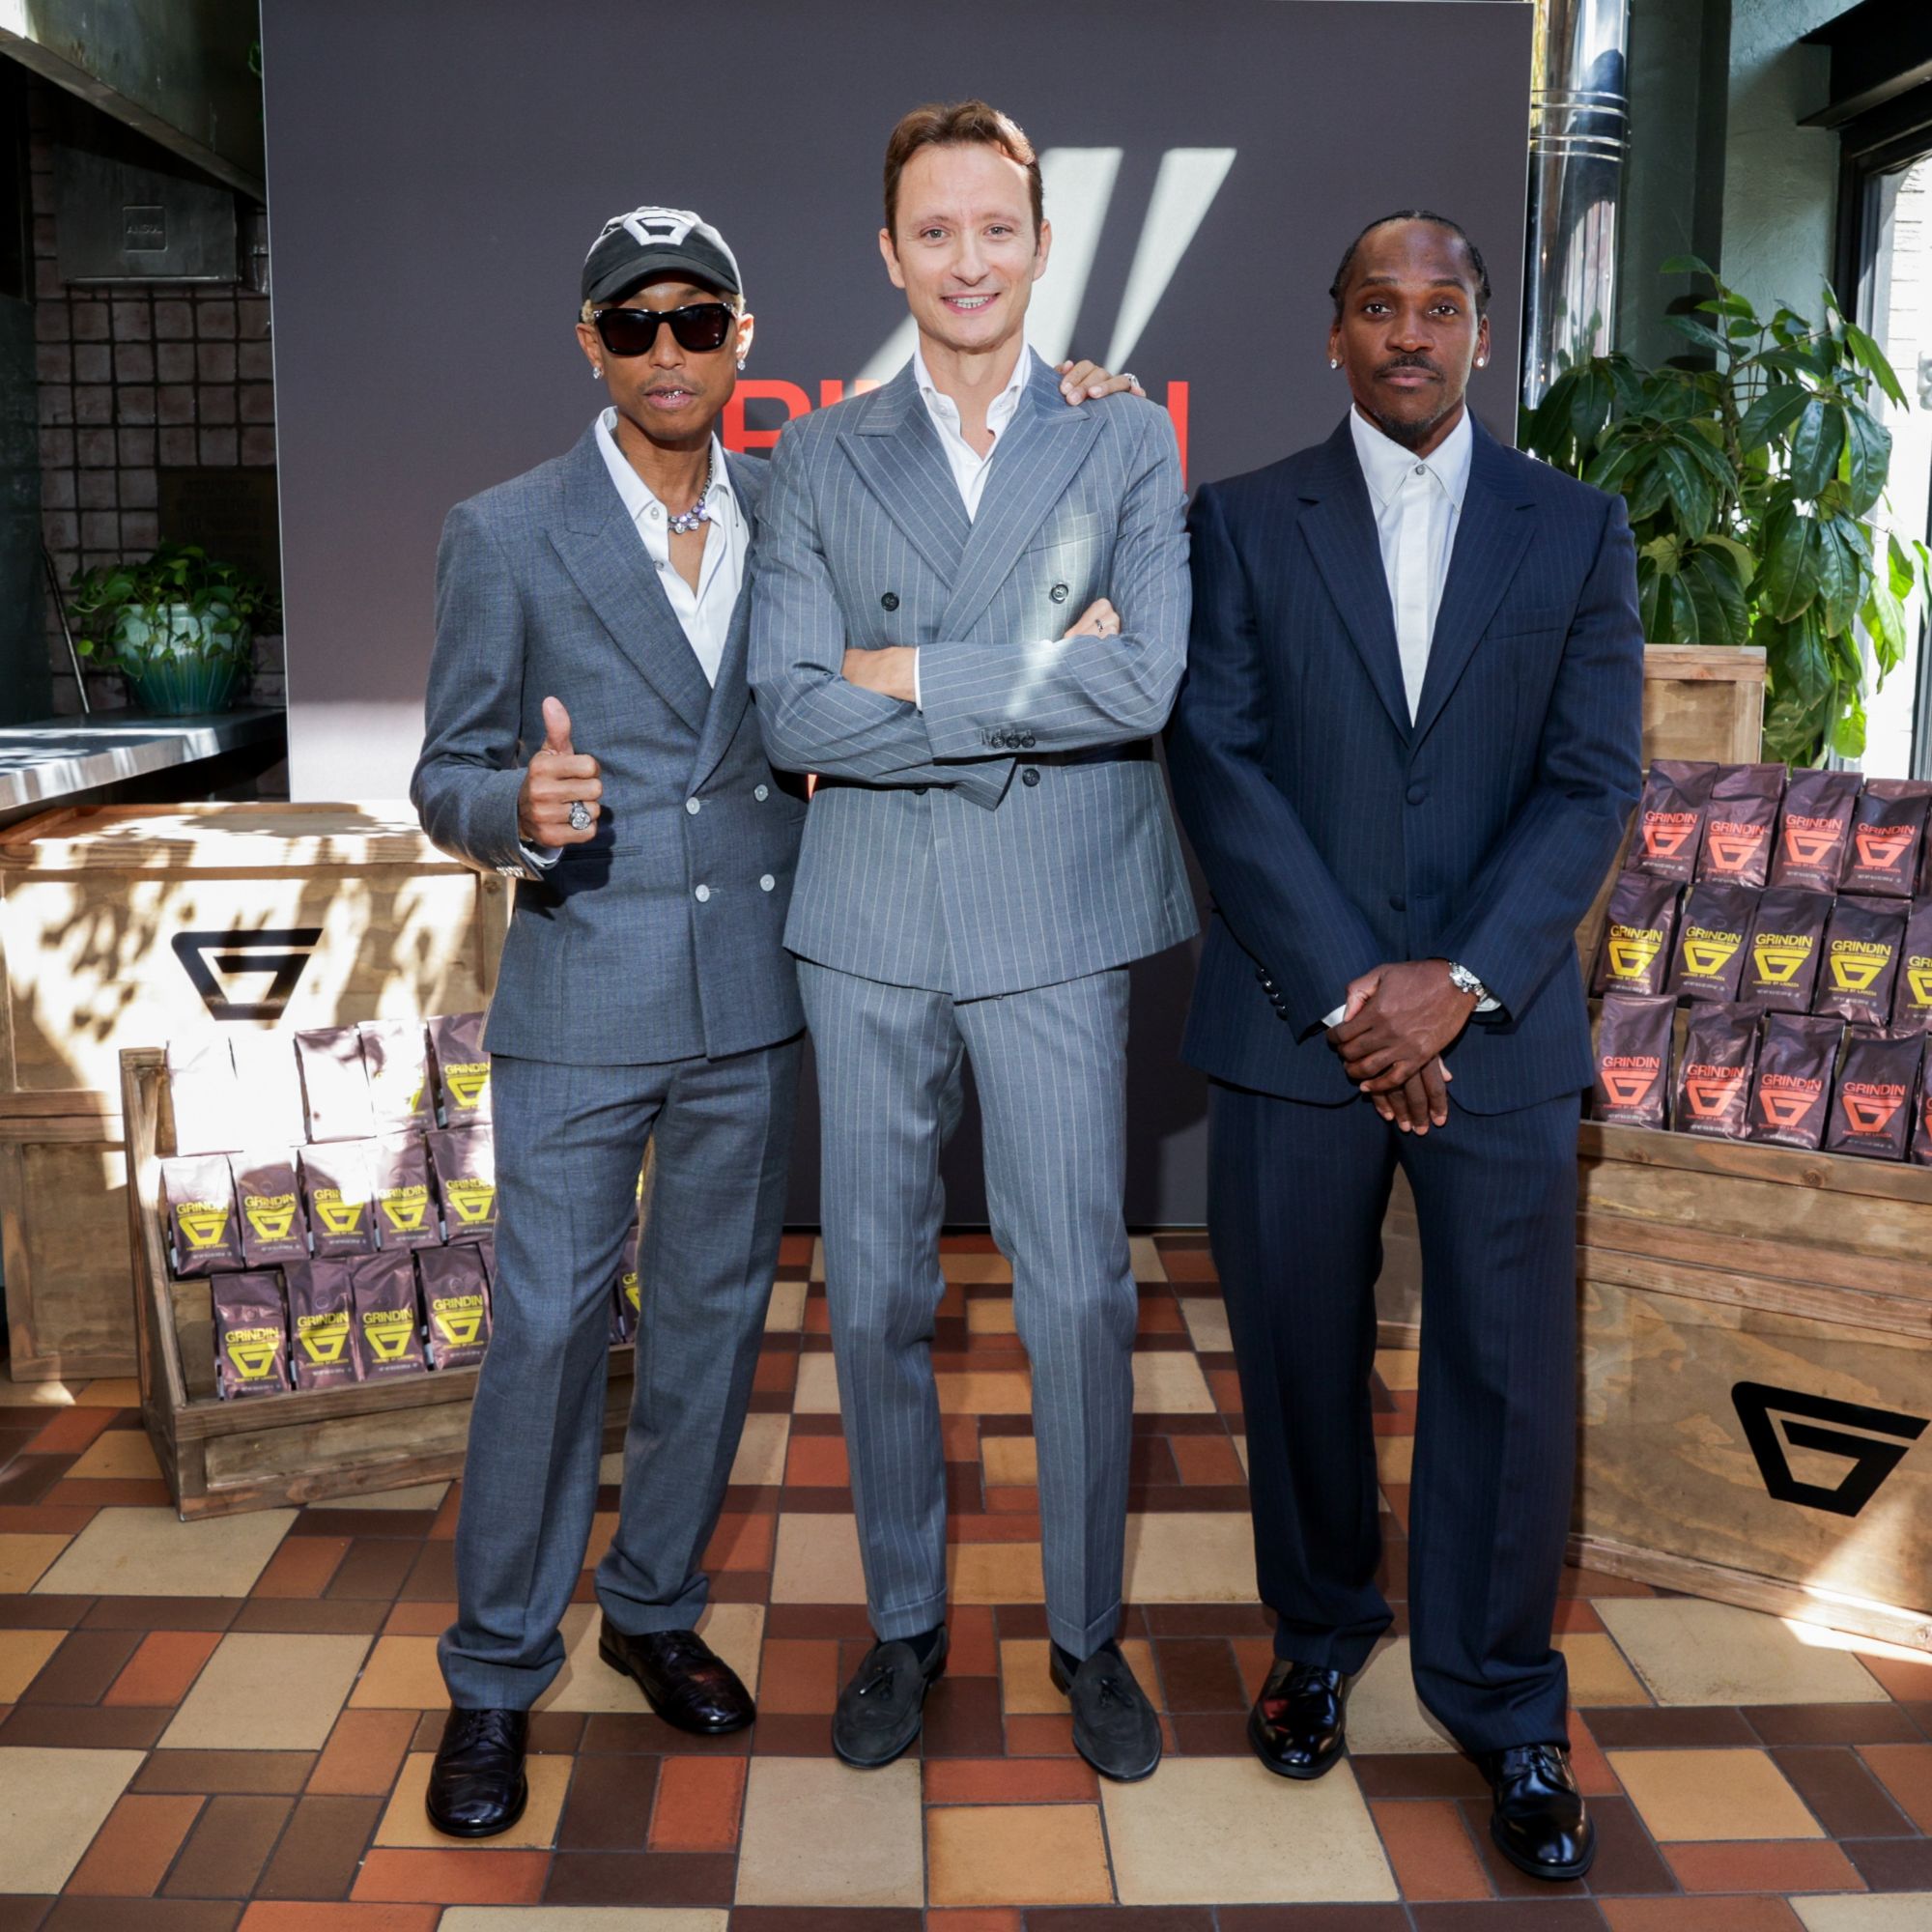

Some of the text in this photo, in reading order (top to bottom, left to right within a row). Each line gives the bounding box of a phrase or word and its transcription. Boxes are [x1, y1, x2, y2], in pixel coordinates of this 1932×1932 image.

[1645, 810, 1698, 824] GRINDIN
[1786, 814, 1843, 830] GRINDIN
[1710, 820, 1766, 836] GRINDIN
[1858, 823, 1917, 836] GRINDIN
[1610, 924, 1663, 943] GRINDIN
[1686, 925, 1743, 944] GRINDIN
[1755, 933, 1813, 948] GRINDIN
[1832, 940, 1891, 955] GRINDIN
[1603, 1056, 1660, 1068] GRINDIN
[1687, 1064, 1745, 1078] GRINDIN
[1761, 1073, 1823, 1092] GRINDIN
[1844, 1082, 1906, 1095] GRINDIN
[378, 1184, 427, 1199] GRINDIN
[244, 1193, 296, 1208] GRINDIN
[433, 1294, 483, 1311] GRINDIN
[298, 1311, 349, 1327] GRINDIN
[362, 1308, 413, 1323] GRINDIN
[225, 1326, 279, 1343] GRINDIN
